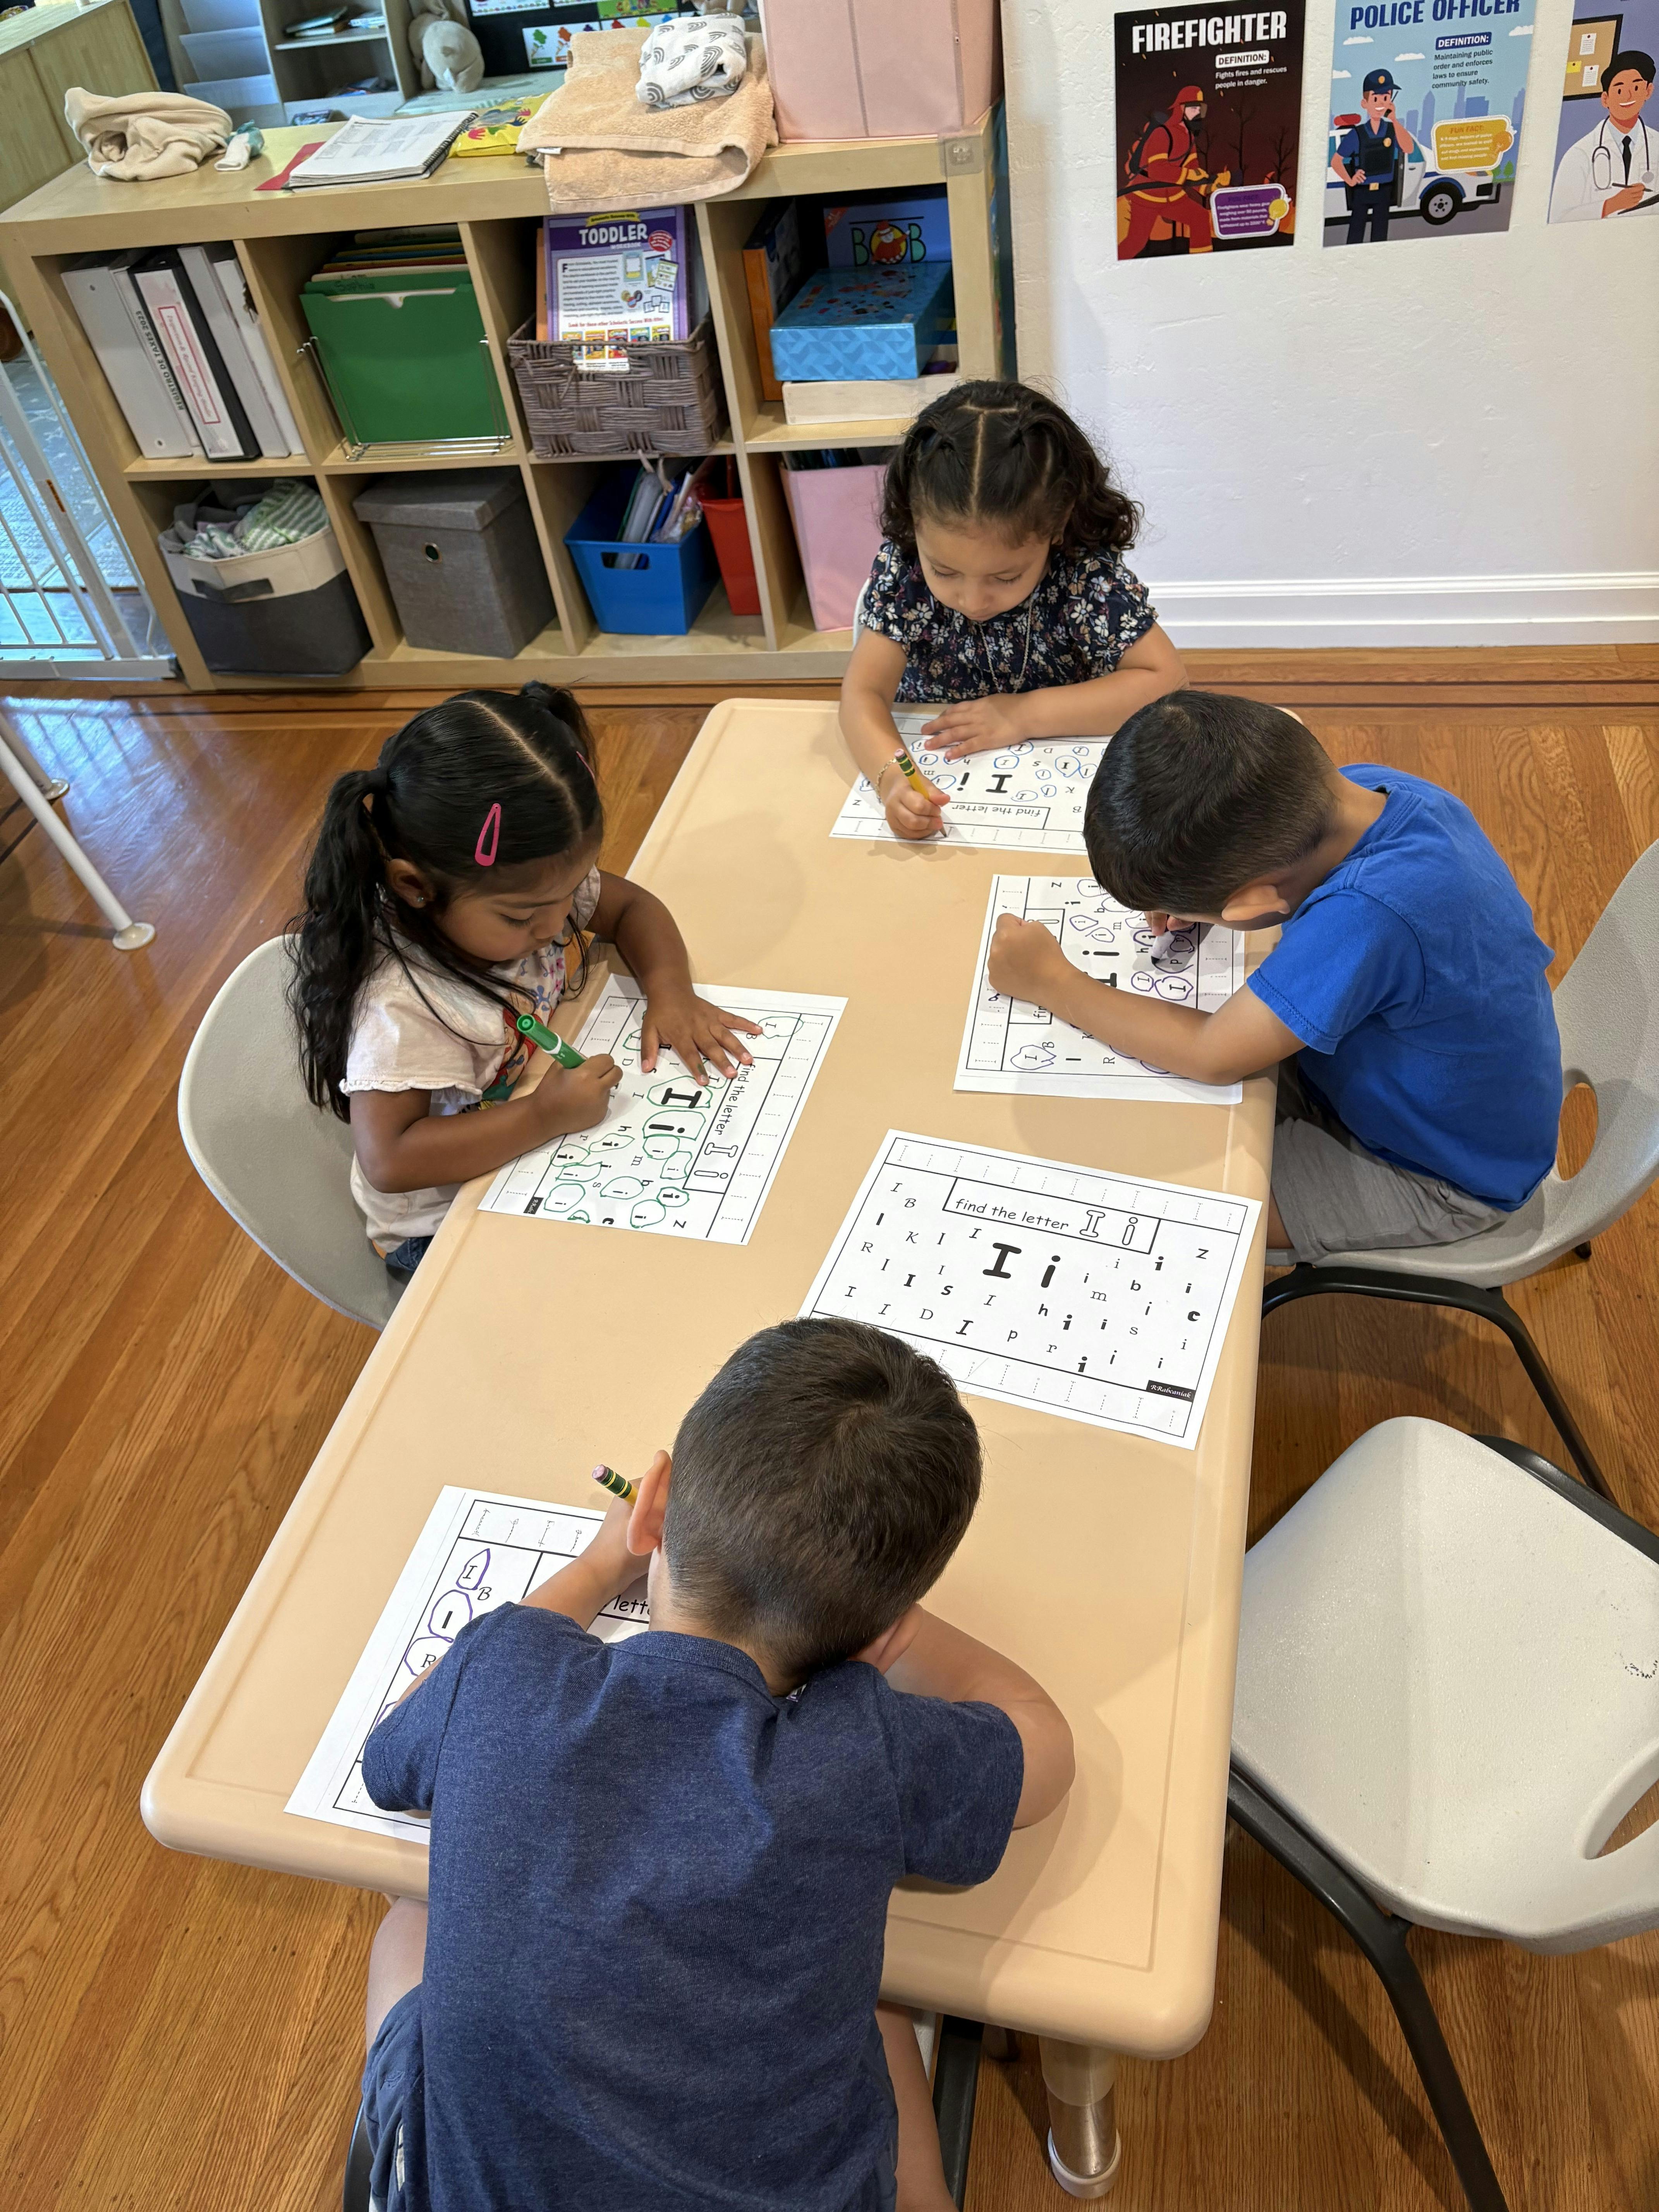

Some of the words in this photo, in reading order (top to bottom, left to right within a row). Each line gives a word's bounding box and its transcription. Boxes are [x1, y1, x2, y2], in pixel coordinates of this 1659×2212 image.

[1350, 0, 1425, 30] POLICE
[1132, 11, 1287, 53] FIREFIGHTER
[1438, 35, 1489, 47] DEFINITION:
[1219, 53, 1267, 65] DEFINITION:
[1434, 51, 1472, 61] Maintaining
[1473, 49, 1493, 58] public
[1465, 58, 1493, 67] enforces
[1216, 71, 1234, 79] Fights
[1215, 81, 1236, 89] people
[1245, 78, 1267, 87] danger.
[1432, 80, 1467, 89] community
[1468, 78, 1489, 86] safety.
[579, 223, 648, 245] TODDLER
[851, 223, 926, 266] BOB
[144, 331, 160, 356] TAXES
[158, 359, 166, 369] DE
[163, 372, 184, 410] REGISTRO
[1013, 742, 1028, 751] I
[957, 773, 970, 791] i
[986, 775, 1013, 793] I
[952, 805, 988, 813] letter
[1113, 922, 1121, 930] m
[738, 1063, 755, 1082] find
[661, 1088, 702, 1108] I
[729, 1085, 745, 1101] the
[715, 1105, 738, 1135] letter
[649, 1124, 685, 1133] i
[704, 1142, 738, 1158] I
[631, 1156, 643, 1166] m
[694, 1170, 728, 1179] i
[890, 1183, 903, 1192] I
[904, 1198, 916, 1208] B
[955, 1199, 987, 1214] find
[992, 1207, 1016, 1219] the
[1022, 1212, 1069, 1230] letter
[1079, 1210, 1106, 1237] I
[1122, 1217, 1138, 1245] i
[905, 1231, 919, 1243] K
[937, 1233, 946, 1245] I
[969, 1228, 982, 1239] I
[860, 1242, 873, 1253] R
[881, 1259, 890, 1271] I
[982, 1243, 1022, 1279] I
[1114, 1259, 1120, 1269] i
[1155, 1256, 1164, 1271] i
[938, 1265, 946, 1275] I
[1041, 1255, 1061, 1288] i
[903, 1274, 916, 1287] I
[1084, 1273, 1089, 1283] i
[1130, 1279, 1141, 1291] b
[1185, 1283, 1192, 1293] i
[845, 1286, 857, 1297] I
[1090, 1291, 1107, 1302] m
[983, 1295, 996, 1306] I
[878, 1304, 891, 1315] I
[919, 1308, 933, 1320] D
[1038, 1304, 1048, 1316] h
[1145, 1302, 1152, 1316] i
[956, 1320, 974, 1336] I
[1063, 1314, 1072, 1330] i
[1101, 1319, 1108, 1330] i
[1046, 1344, 1057, 1353] r
[1180, 1339, 1187, 1350] i
[1110, 1350, 1117, 1365] i
[1158, 1357, 1163, 1369] i
[1078, 1357, 1087, 1372] i
[463, 1565, 477, 1579] I
[477, 1587, 492, 1600] B
[421, 1654, 437, 1668] R
